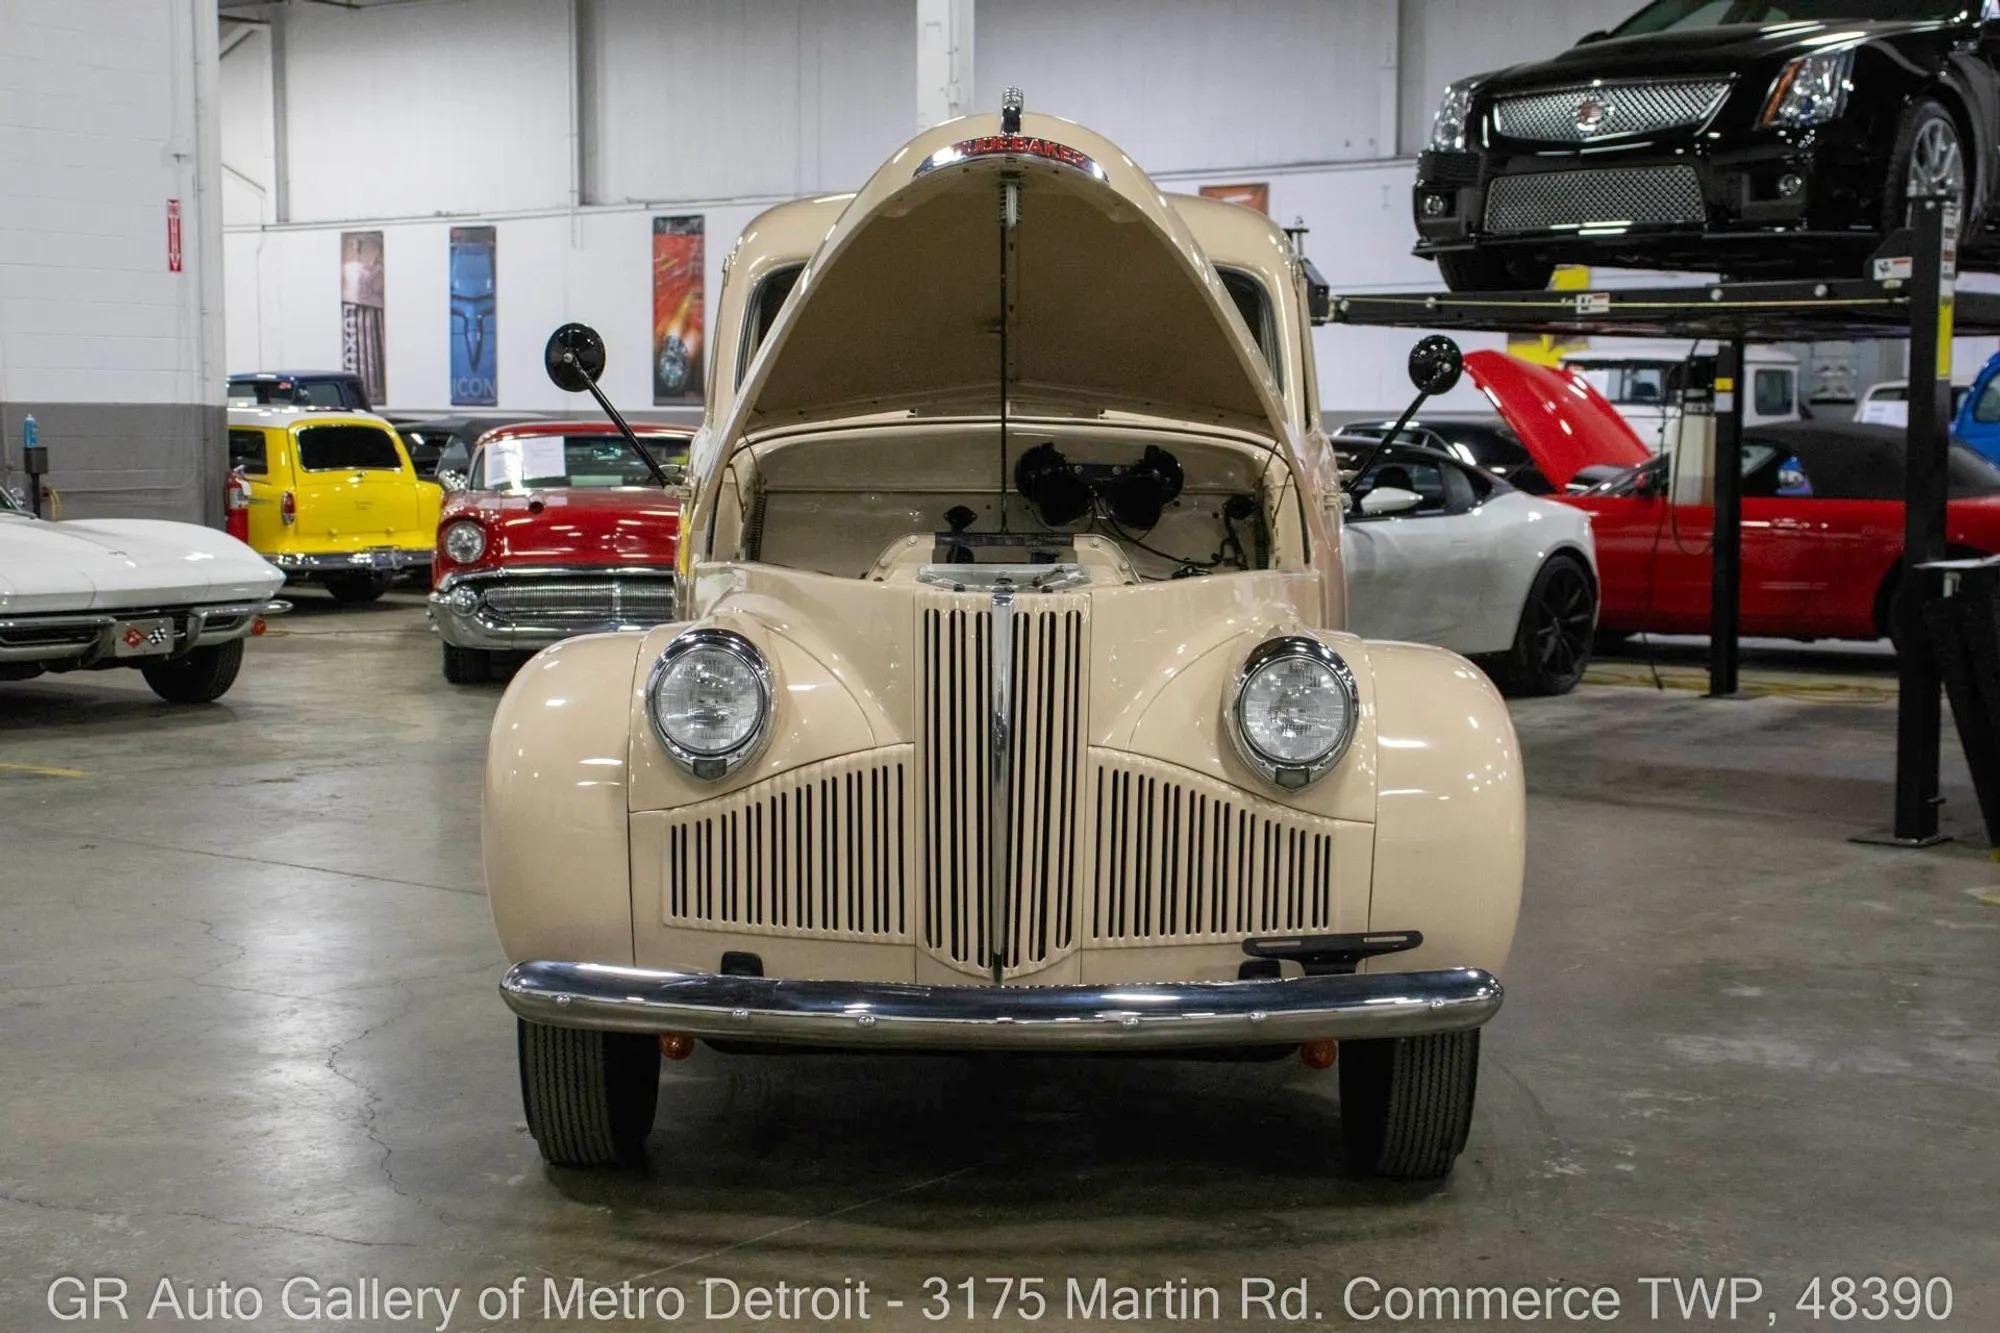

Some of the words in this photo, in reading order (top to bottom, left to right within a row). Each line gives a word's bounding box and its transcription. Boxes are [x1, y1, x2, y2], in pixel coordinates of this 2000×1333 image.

[944, 135, 1089, 170] TUDEBAKER
[343, 303, 358, 375] LUXU
[452, 377, 497, 397] ICON
